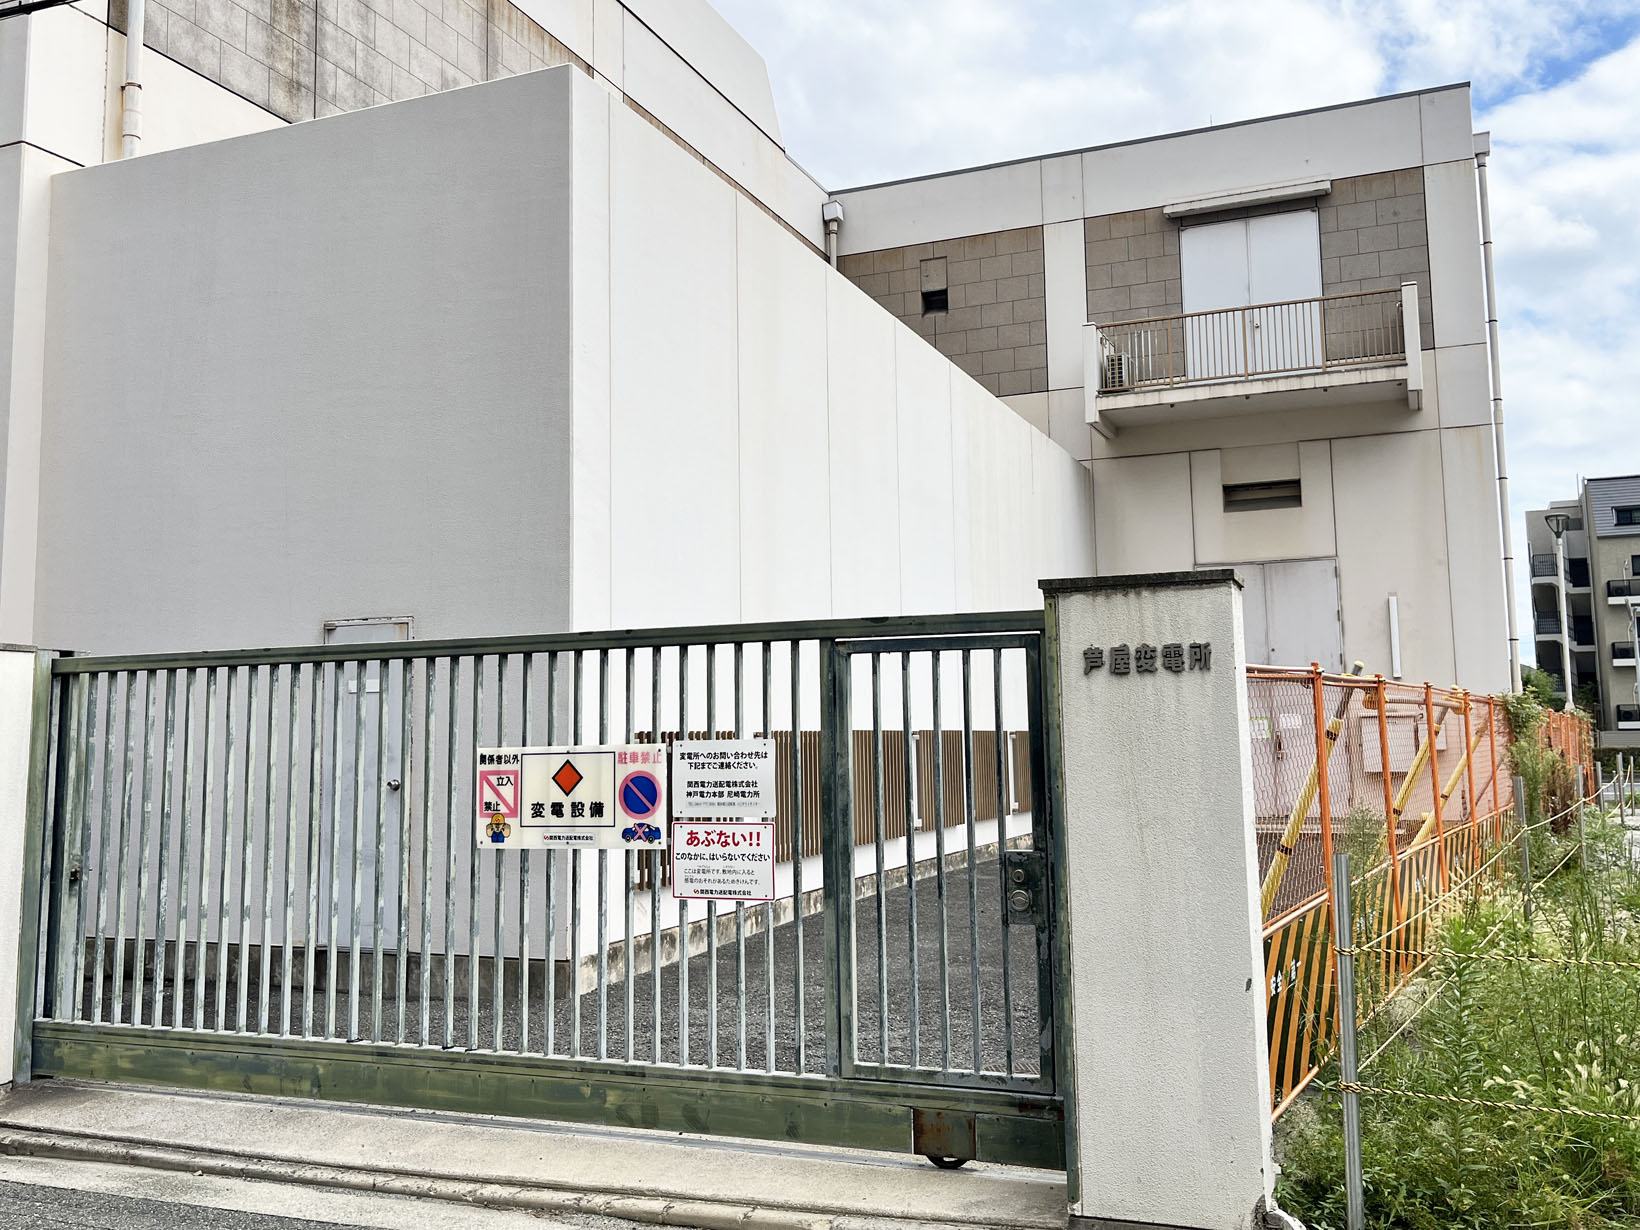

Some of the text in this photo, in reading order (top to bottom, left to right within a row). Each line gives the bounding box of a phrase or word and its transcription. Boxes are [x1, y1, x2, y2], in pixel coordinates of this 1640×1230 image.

[1083, 642, 1213, 675] 芦屋変電所
[479, 753, 520, 765] 関係者以外
[617, 751, 663, 765] 駐車禁止
[679, 751, 769, 761] 変電所へのお問い合わせ先は
[687, 761, 758, 770] 下記までご連絡ください。
[496, 776, 514, 786] 立入
[686, 780, 759, 789] 関西電力送配電株式会社
[686, 790, 760, 799] 神戸電力本部 尼崎電力所
[483, 801, 501, 812] 禁止
[530, 801, 605, 819] 変電設備
[686, 829, 761, 848] あぶない!!
[675, 852, 771, 862] このなかに、はいらないでください
